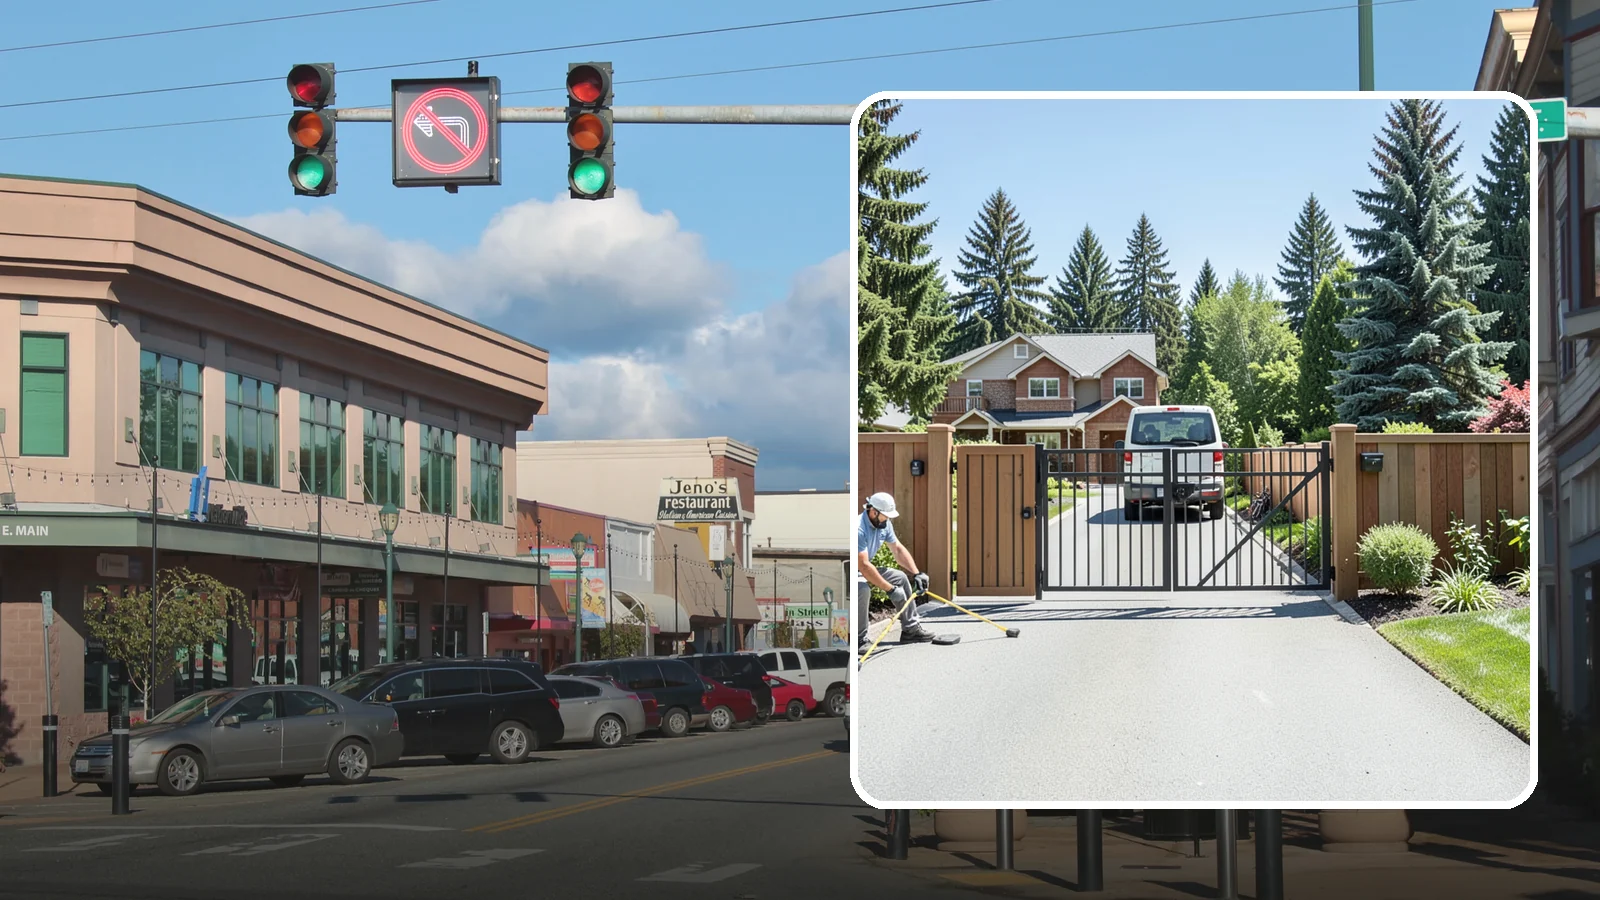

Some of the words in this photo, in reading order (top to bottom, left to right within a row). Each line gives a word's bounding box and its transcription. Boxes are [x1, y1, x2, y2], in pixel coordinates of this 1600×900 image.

[669, 479, 728, 494] Jeno's
[664, 496, 731, 509] restaurant
[658, 509, 681, 520] Italian
[686, 509, 714, 519] American
[714, 509, 738, 519] Cuisine
[2, 525, 13, 536] E.
[15, 525, 49, 536] MAIN
[797, 607, 828, 616] Street
[790, 619, 824, 627] lass
